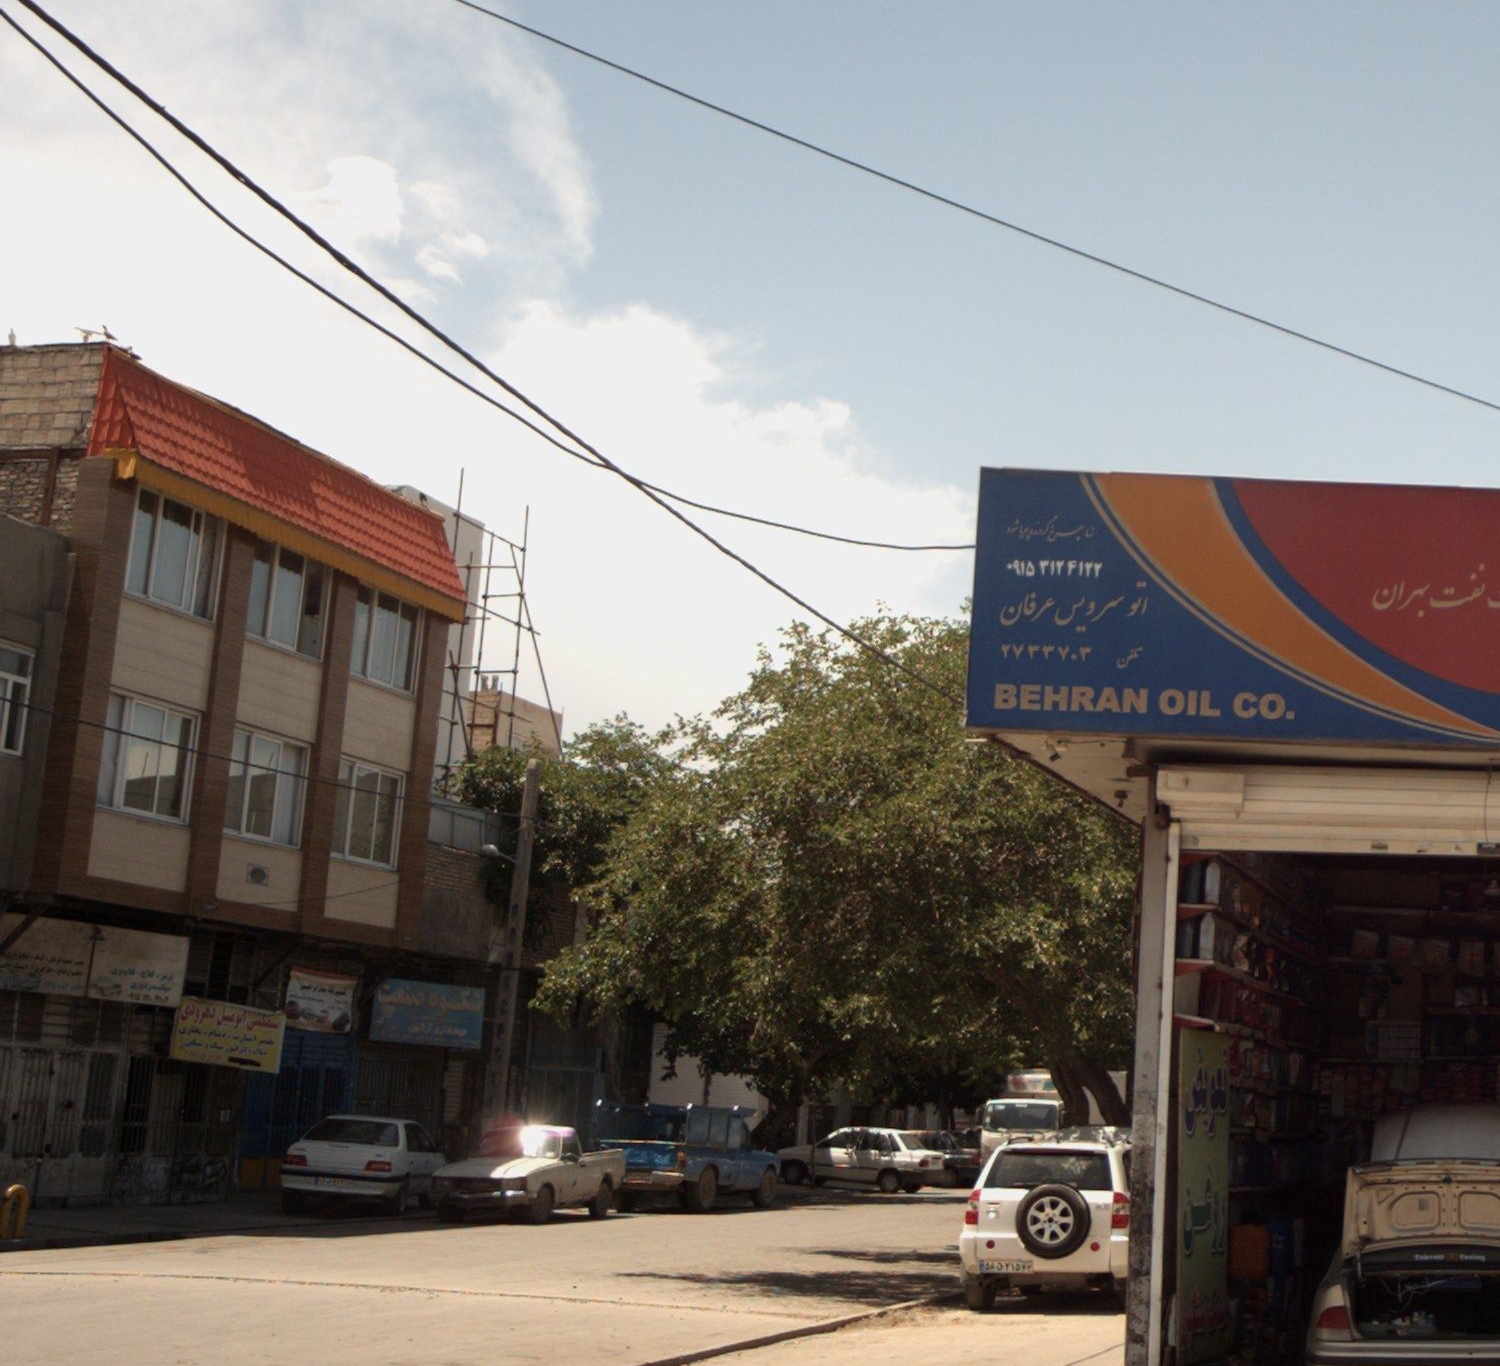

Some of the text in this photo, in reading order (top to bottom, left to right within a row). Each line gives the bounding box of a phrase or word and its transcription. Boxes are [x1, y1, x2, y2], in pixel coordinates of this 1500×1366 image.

[1006, 559, 1035, 578] ۰۹۱۵
[1428, 563, 1485, 609] نفت
[999, 580, 1149, 633] اتو سرویس عرفان
[1371, 577, 1430, 618] بهران
[993, 683, 1296, 720] BEHRAN OIL CO.
